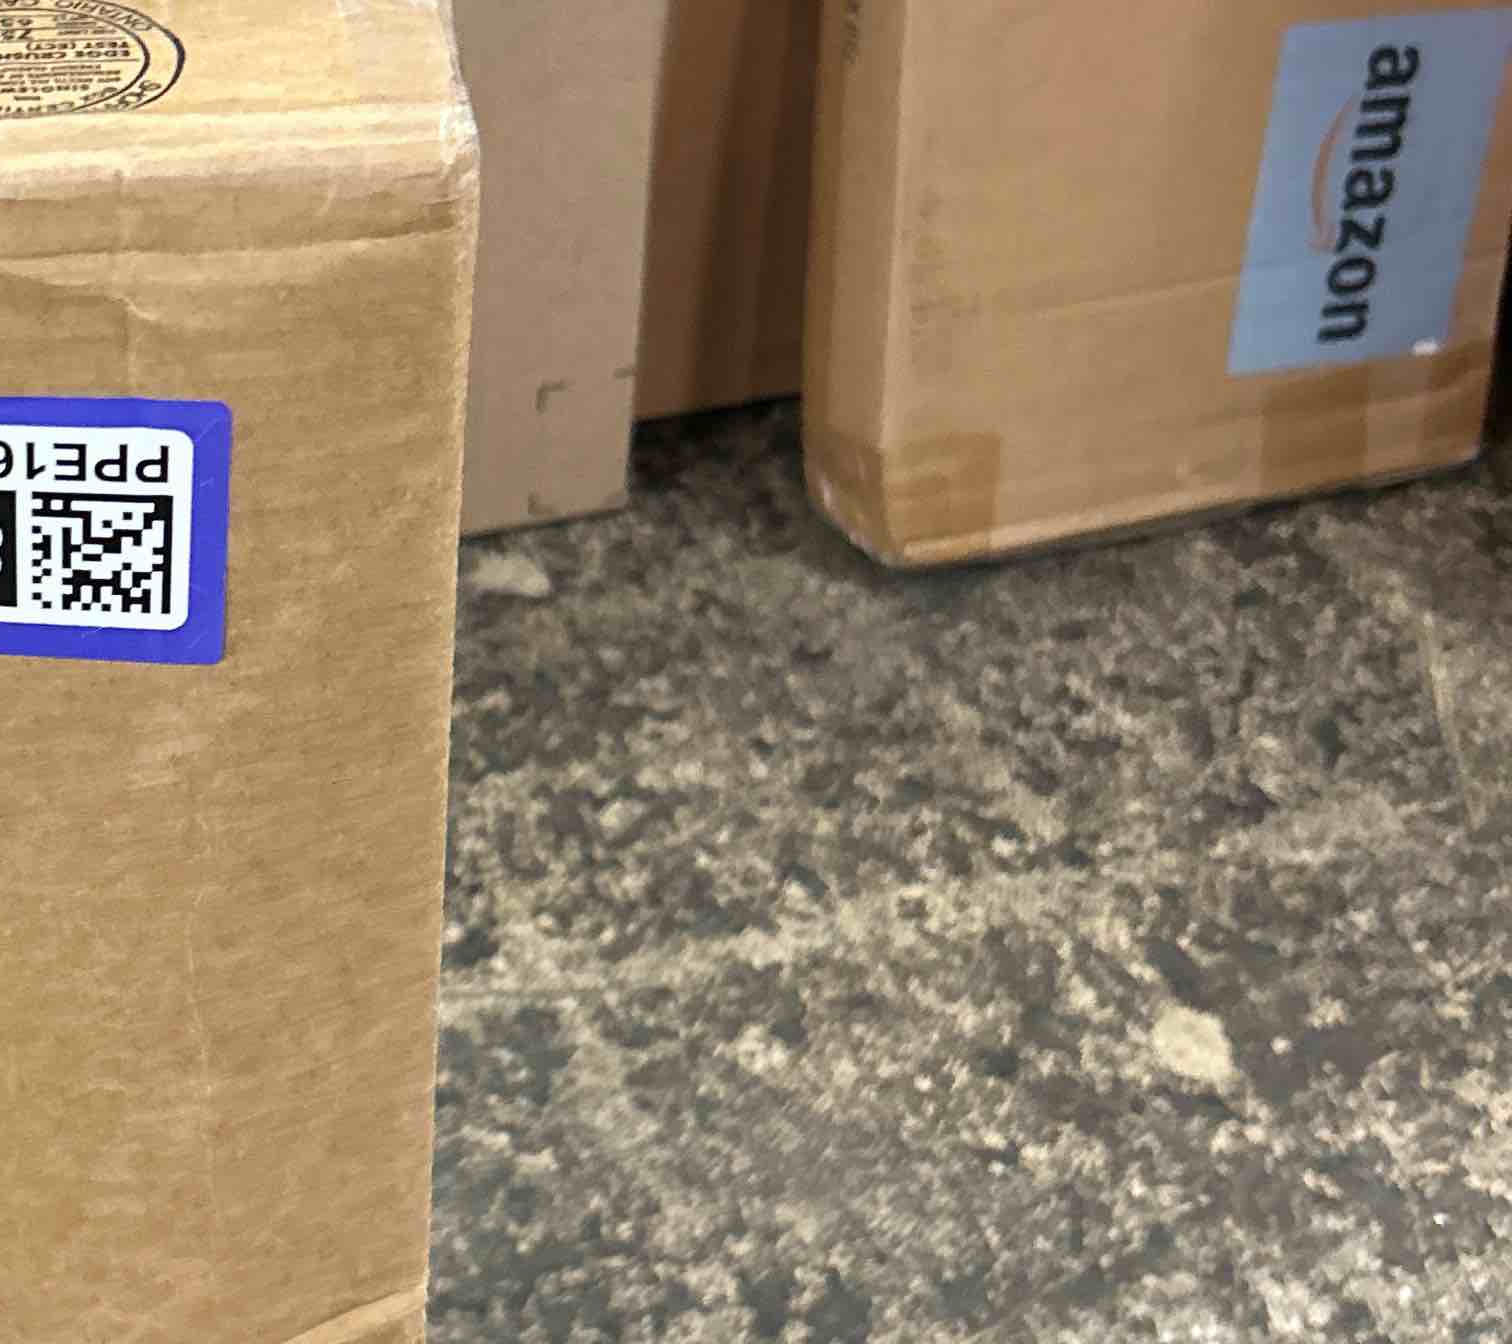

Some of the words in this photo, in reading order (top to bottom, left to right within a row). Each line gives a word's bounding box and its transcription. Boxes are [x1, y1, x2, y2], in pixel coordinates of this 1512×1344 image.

[84, 40, 131, 51] TEST
[73, 49, 132, 59] EDGE
[1317, 44, 1420, 344] amazon
